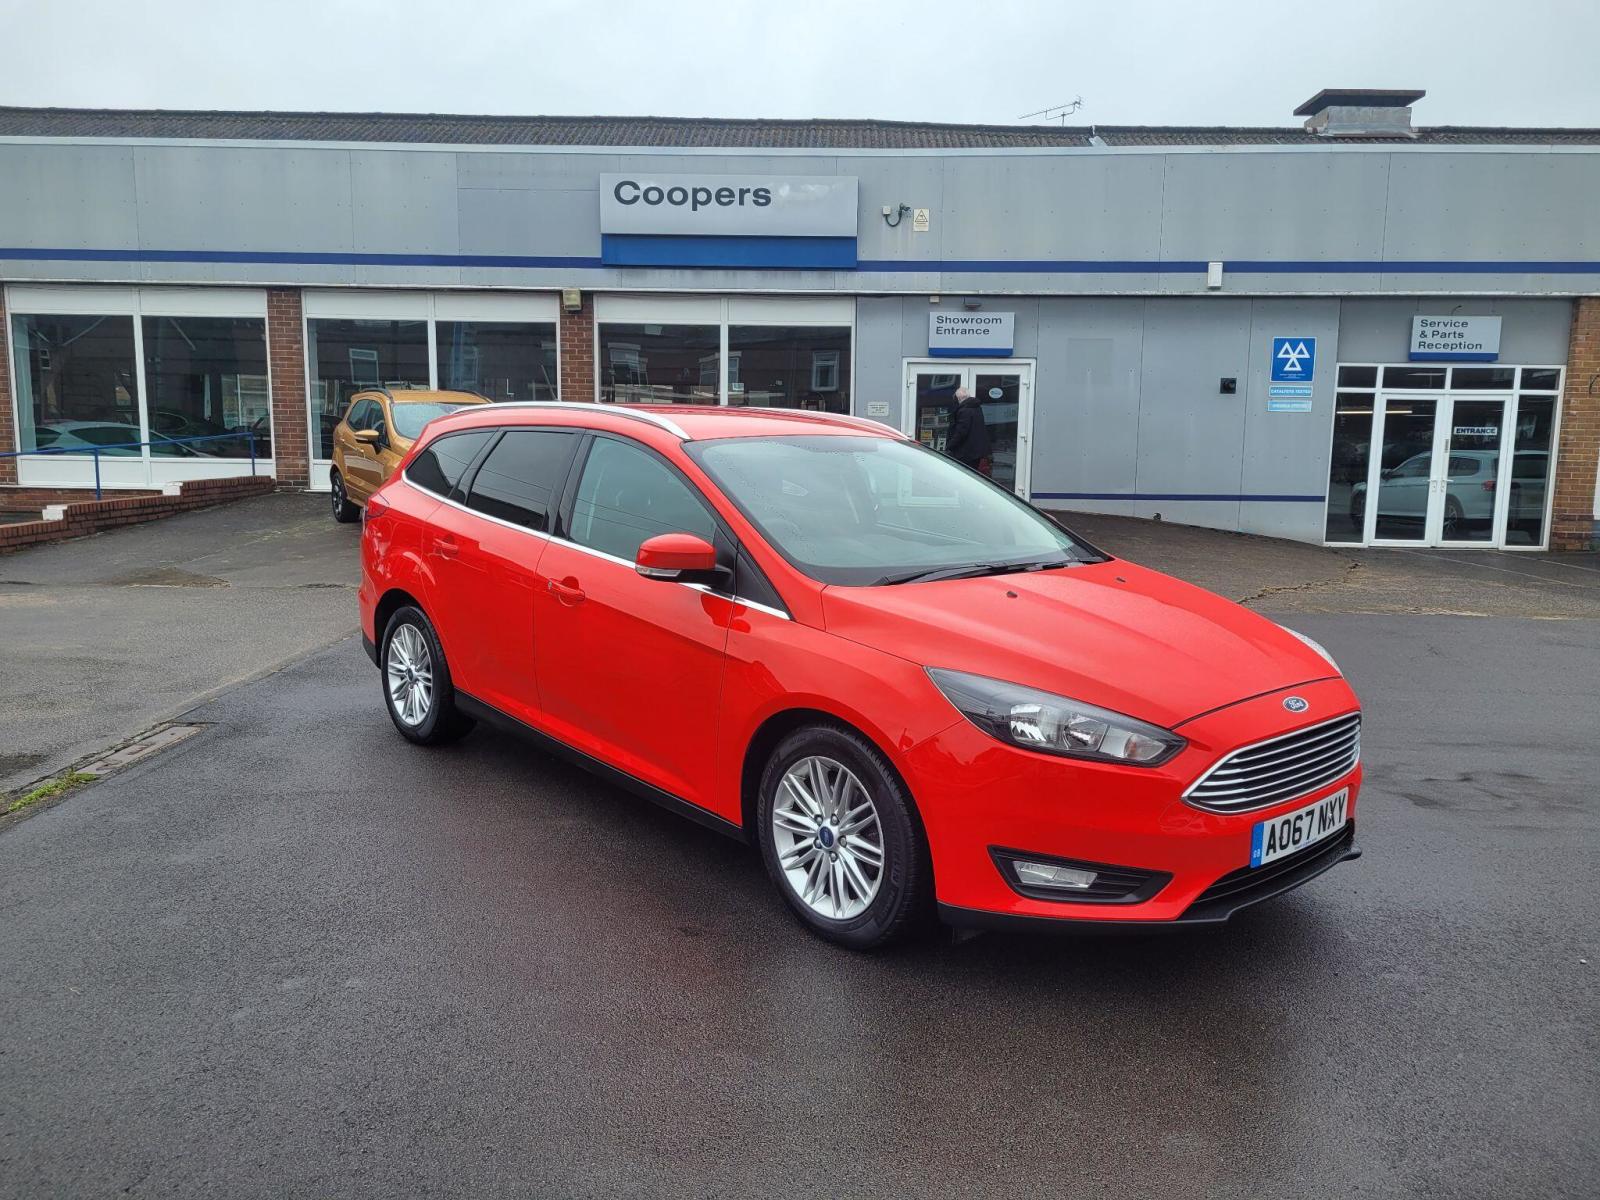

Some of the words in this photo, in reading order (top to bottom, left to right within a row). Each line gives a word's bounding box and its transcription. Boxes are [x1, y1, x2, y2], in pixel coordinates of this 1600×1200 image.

[613, 180, 772, 212] Coopers
[936, 315, 1002, 325] Showroom
[1420, 319, 1469, 328] Service
[935, 326, 990, 336] Entrance
[1419, 330, 1428, 339] &
[1431, 330, 1465, 339] Parts
[1418, 341, 1483, 351] Reception
[1317, 792, 1346, 835] NXY
